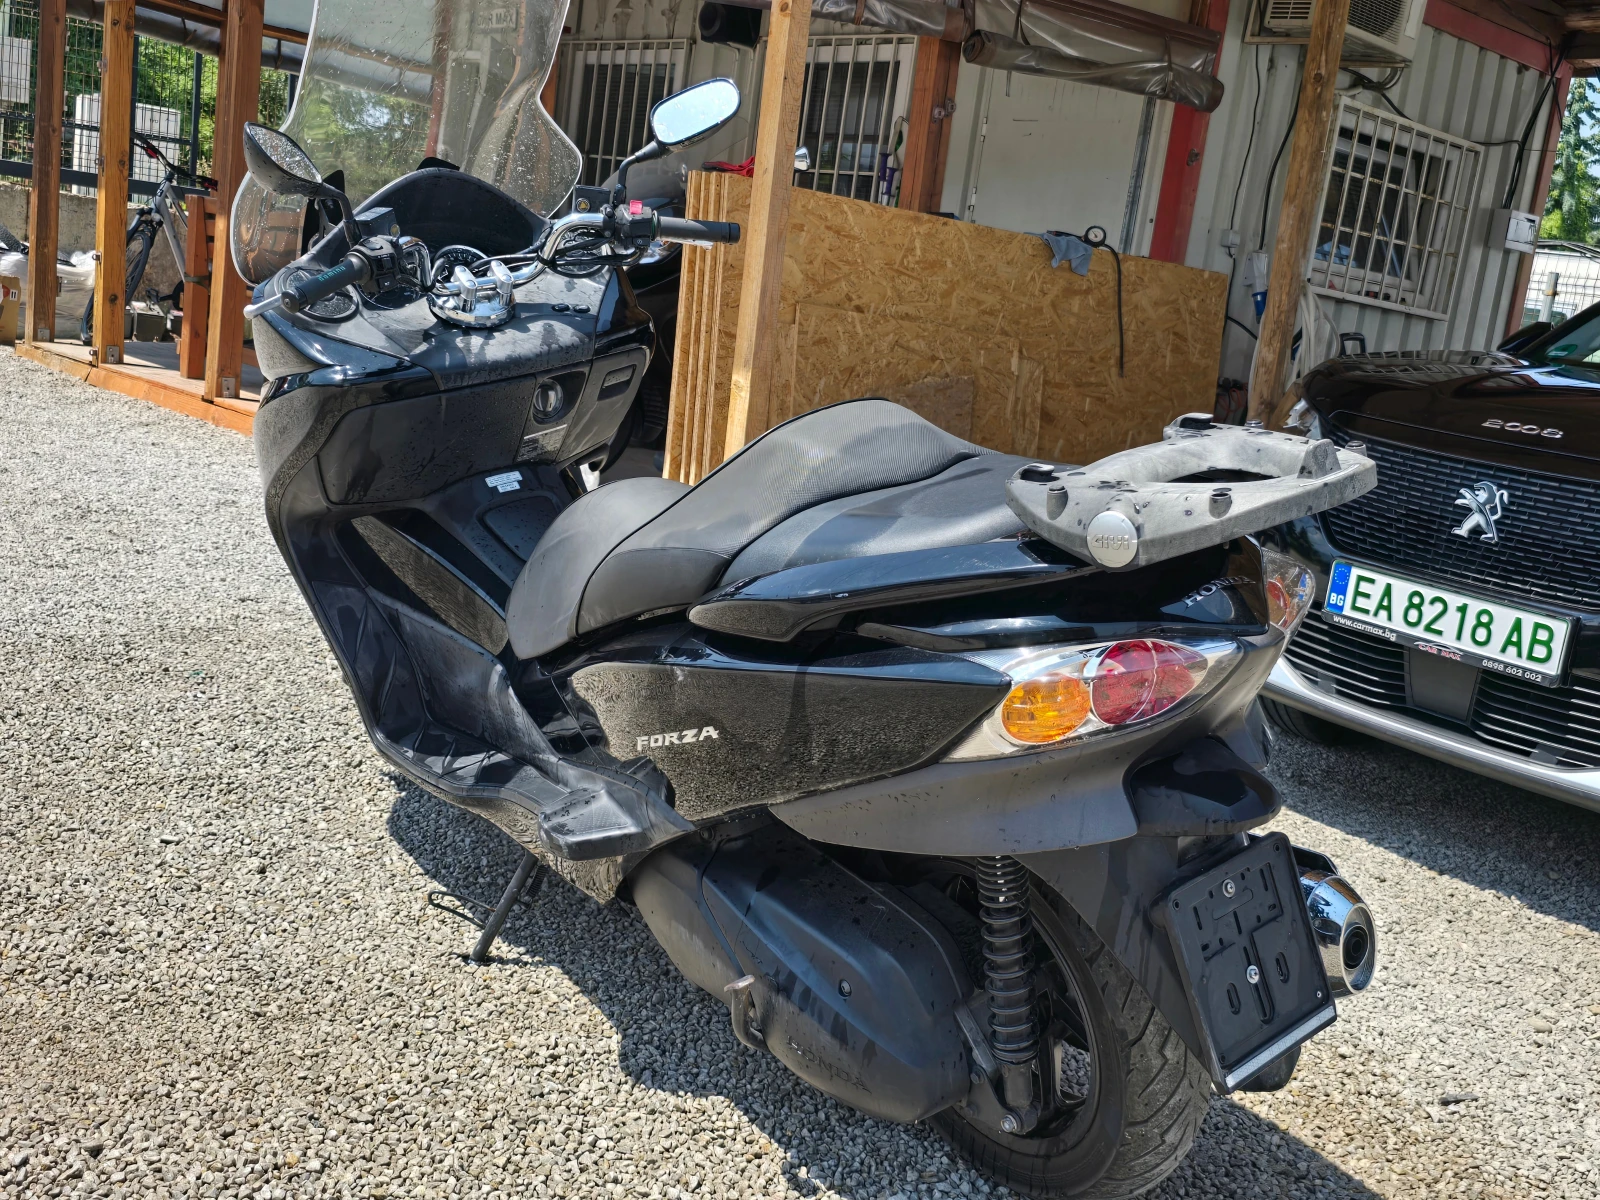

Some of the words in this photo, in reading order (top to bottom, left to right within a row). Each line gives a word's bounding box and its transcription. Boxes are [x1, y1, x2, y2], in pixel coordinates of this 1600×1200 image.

[1481, 419, 1564, 438] 2008
[1329, 592, 1345, 606] BG
[1333, 615, 1397, 641] www.carmax.bg
[1350, 574, 1392, 622] EA
[1403, 589, 1494, 648] 8218
[1499, 616, 1555, 664] AB
[1482, 659, 1504, 671] 0898
[1505, 666, 1523, 677] 602
[1524, 671, 1542, 682] 002
[636, 725, 719, 751] FORZA
